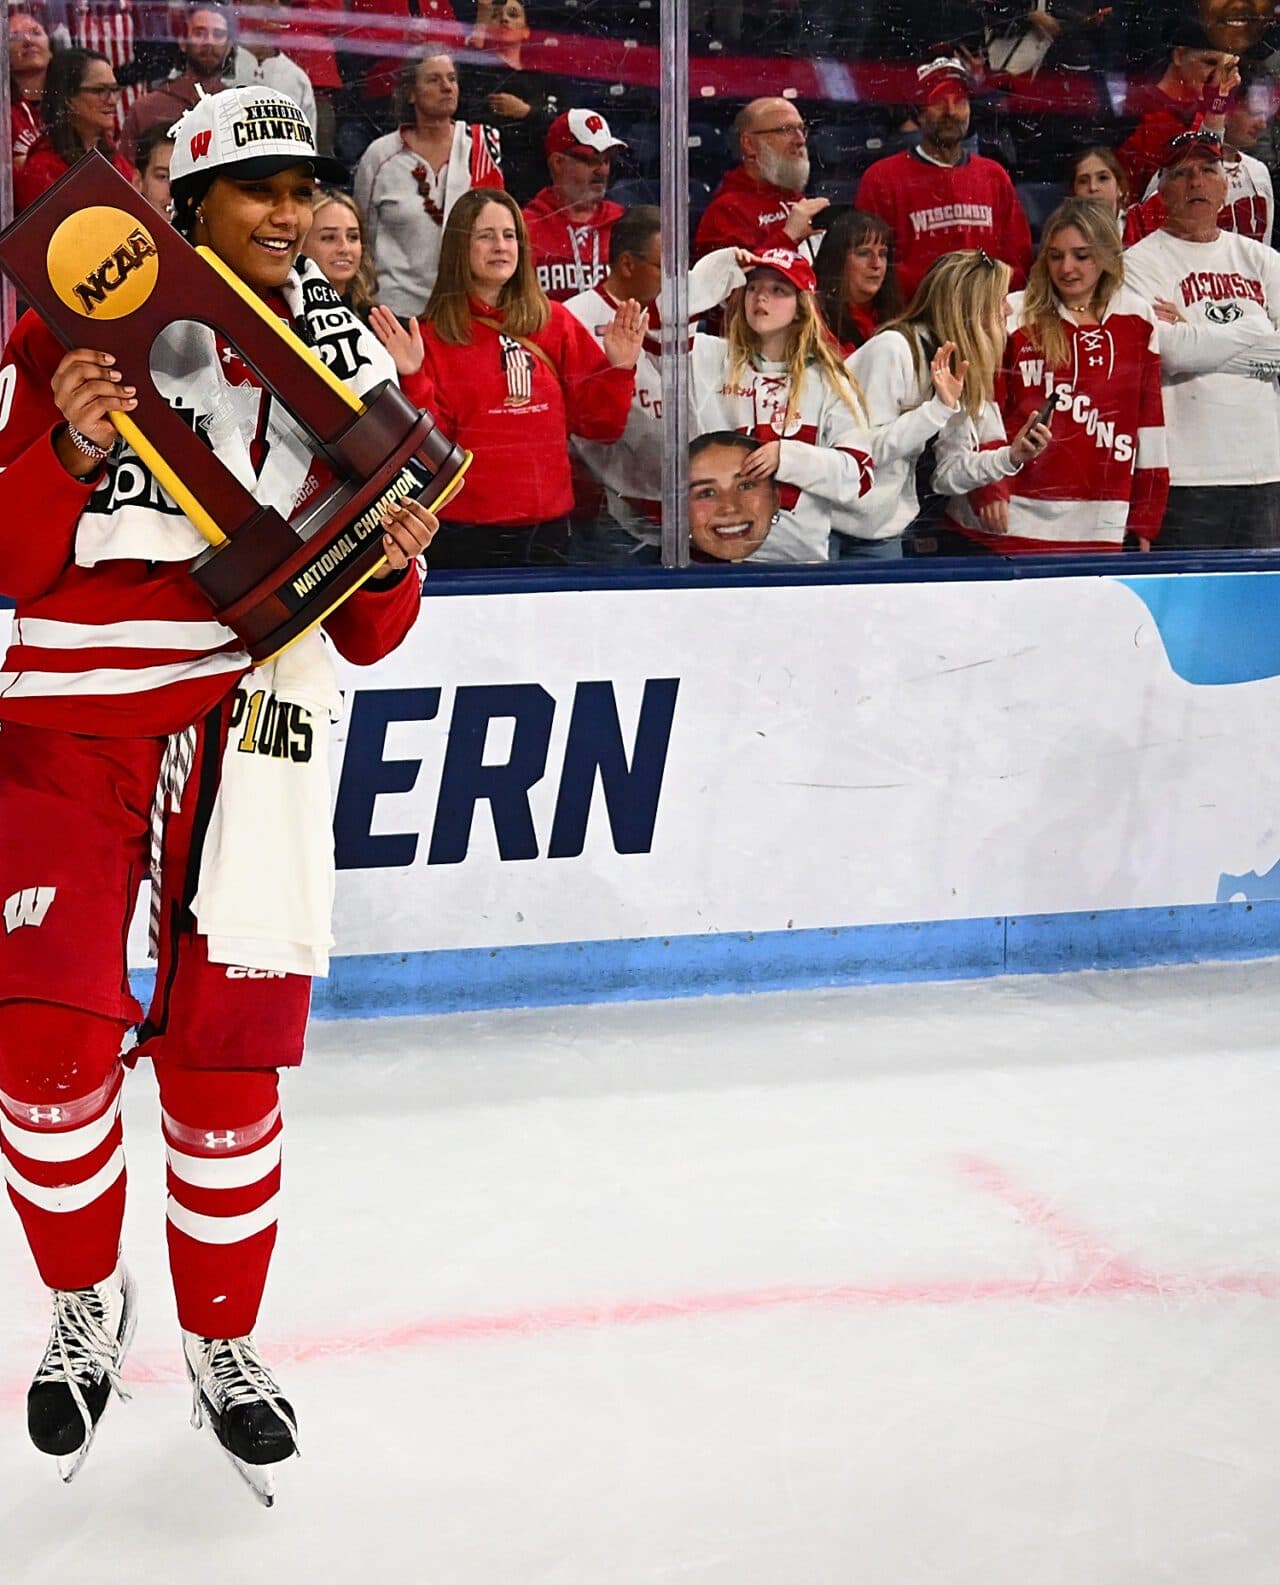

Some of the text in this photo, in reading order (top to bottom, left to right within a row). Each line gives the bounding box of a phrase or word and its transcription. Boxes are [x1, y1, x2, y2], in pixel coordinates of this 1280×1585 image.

[585, 115, 604, 134] W
[190, 130, 212, 163] W
[909, 203, 993, 232] WISCONSIN
[71, 227, 157, 315] NCAA
[536, 264, 611, 292] BADGE
[1019, 359, 1137, 475] WISCONS
[291, 474, 320, 508] 2026
[292, 466, 424, 598] NATIONAL CHAMPION
[3, 886, 57, 934] W
[225, 966, 287, 979] CCM
